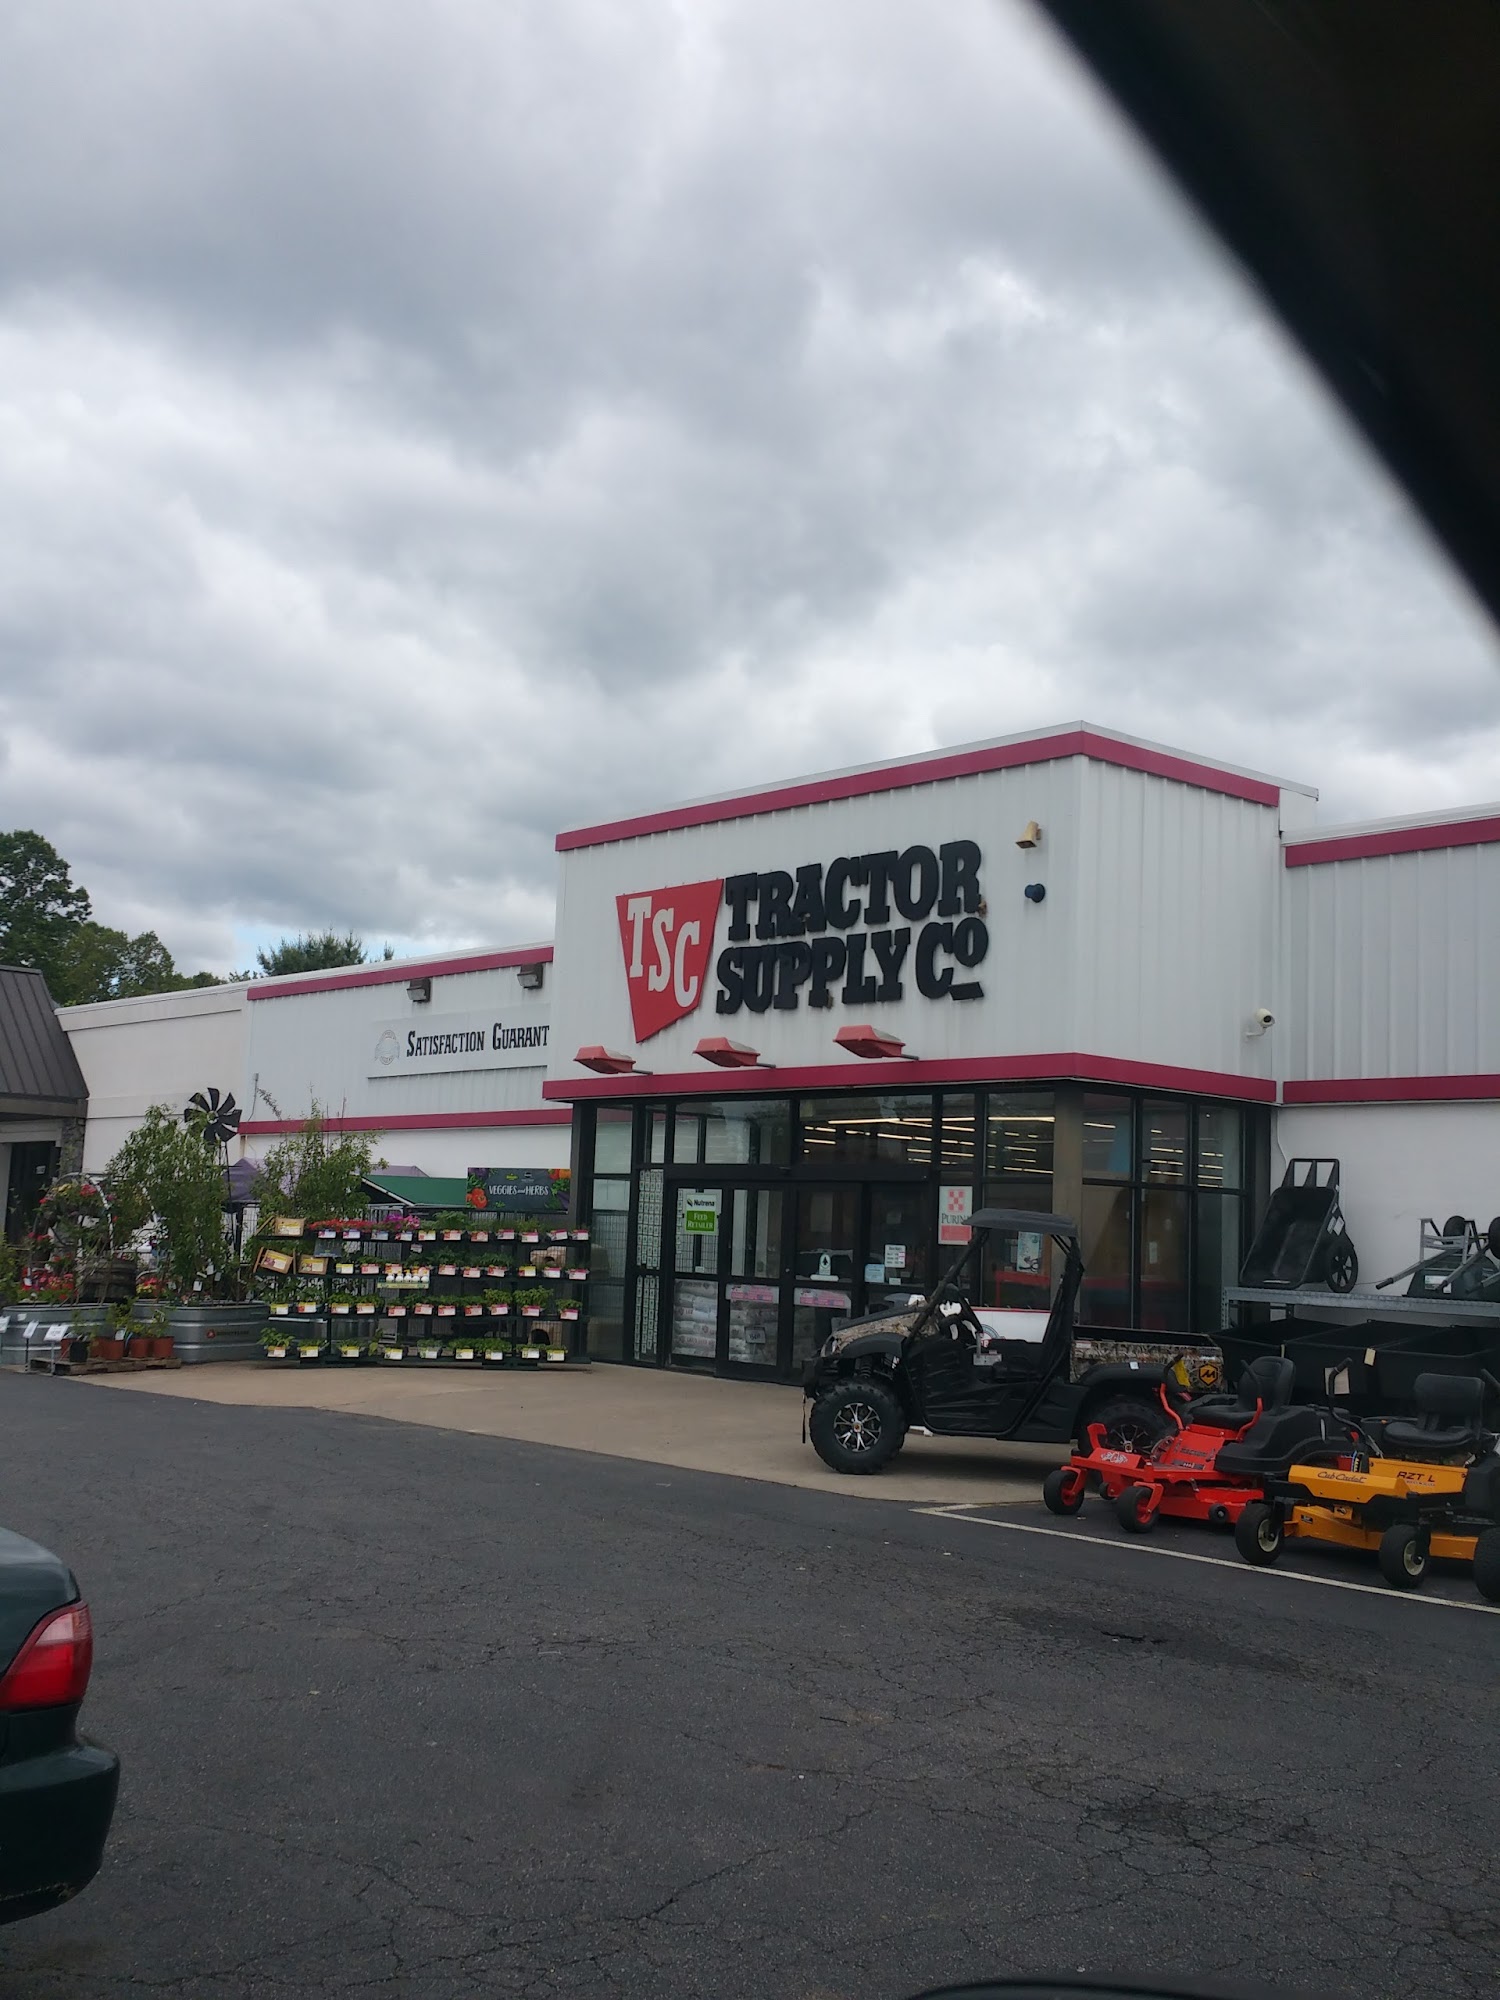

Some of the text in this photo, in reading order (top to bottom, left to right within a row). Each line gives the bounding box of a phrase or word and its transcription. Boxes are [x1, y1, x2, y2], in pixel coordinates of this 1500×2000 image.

[725, 839, 981, 941] TRACTOR
[627, 896, 701, 1008] TSC
[716, 927, 911, 1014] SUPPLY
[406, 1030, 485, 1057] SATISFACTION
[489, 1185, 517, 1195] VEGGIES
[525, 1185, 549, 1195] HERBS
[693, 1199, 715, 1207] Nutrena
[687, 1221, 713, 1229] RETAILER
[1317, 1471, 1336, 1480] Cub
